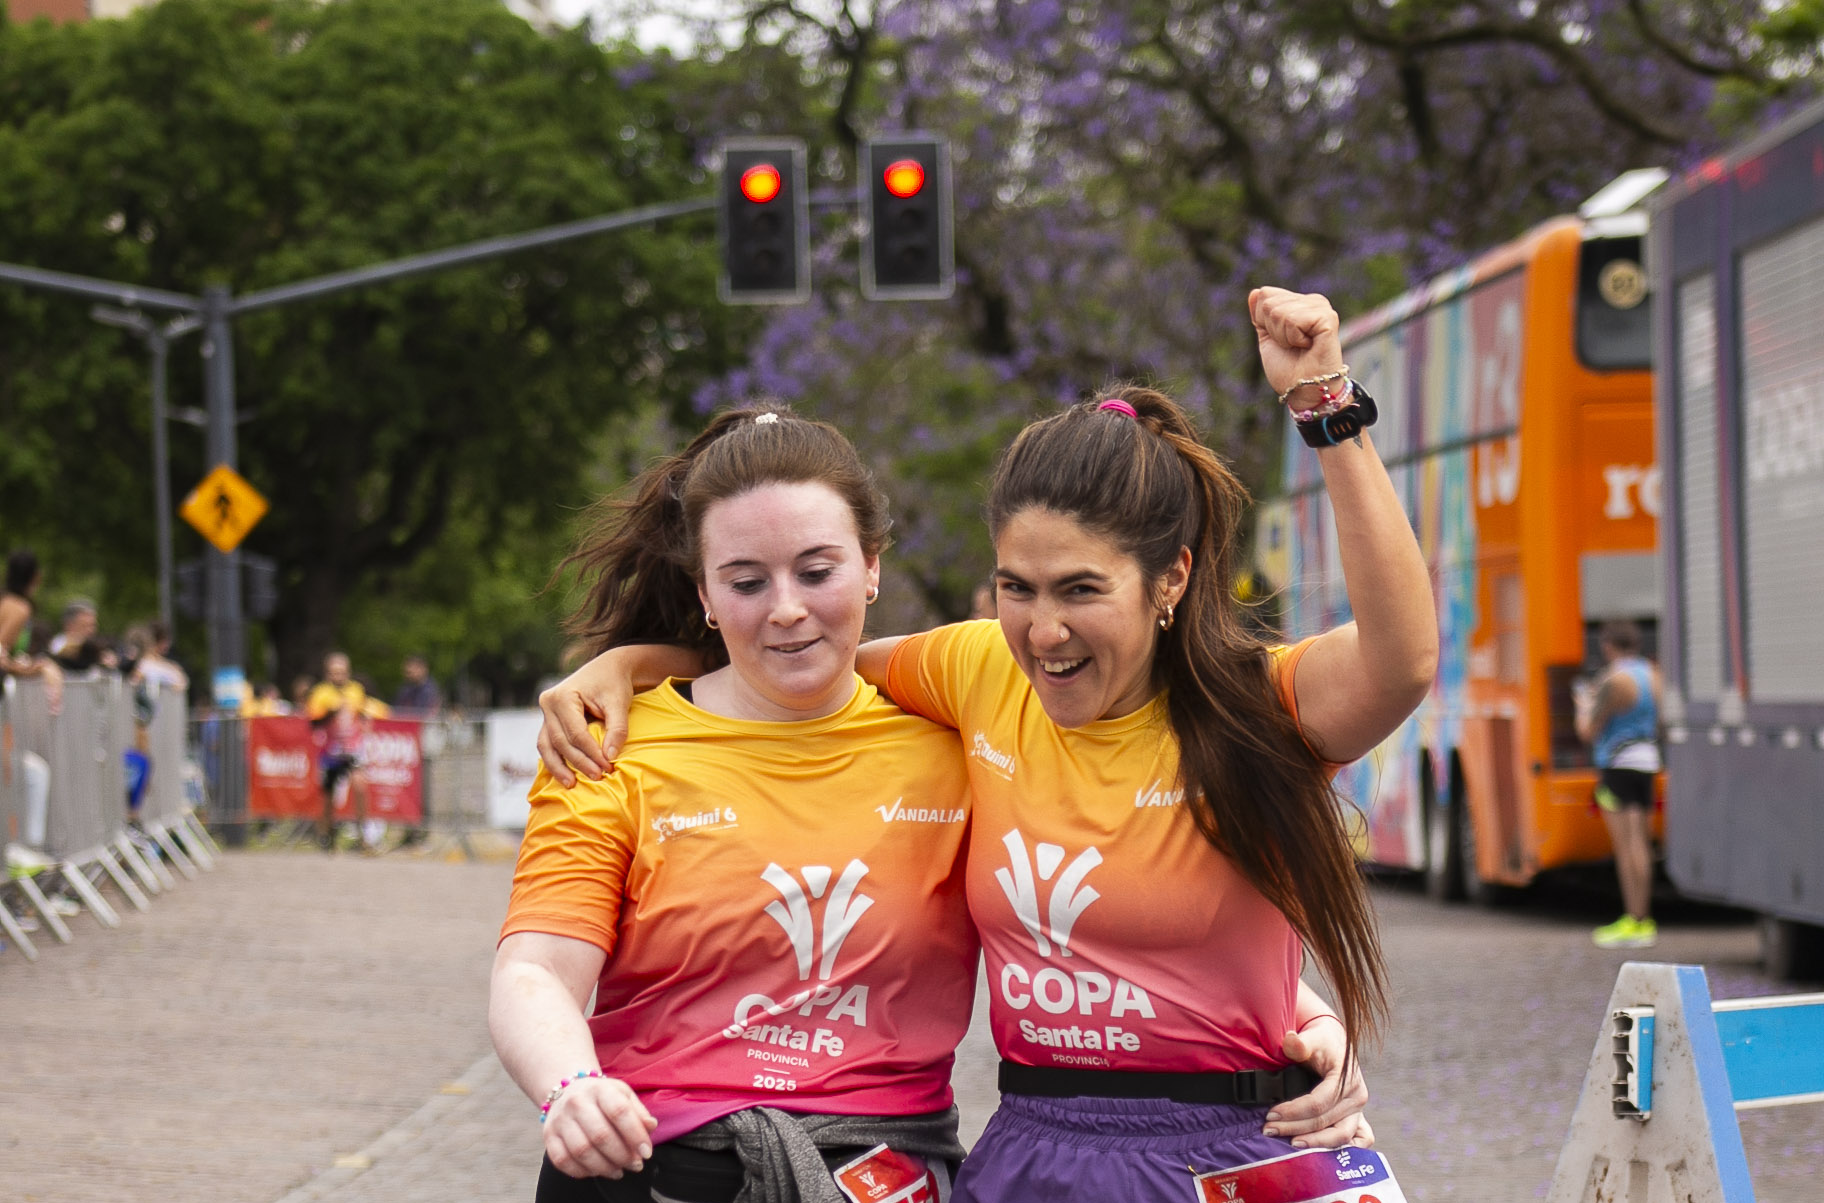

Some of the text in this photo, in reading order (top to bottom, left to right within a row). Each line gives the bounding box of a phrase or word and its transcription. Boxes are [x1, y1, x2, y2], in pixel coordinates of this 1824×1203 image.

[724, 807, 737, 822] 6
[874, 796, 965, 823] VANDALIA
[1001, 963, 1157, 1019] COPA
[722, 1023, 844, 1057] Santa Fe
[1019, 1019, 1140, 1052] Santa Fe
[746, 1048, 809, 1068] PROVINCIA
[1052, 1053, 1110, 1067] PROVINCIA
[752, 1075, 797, 1092] 2025
[1336, 1164, 1375, 1181] Santa Fe
